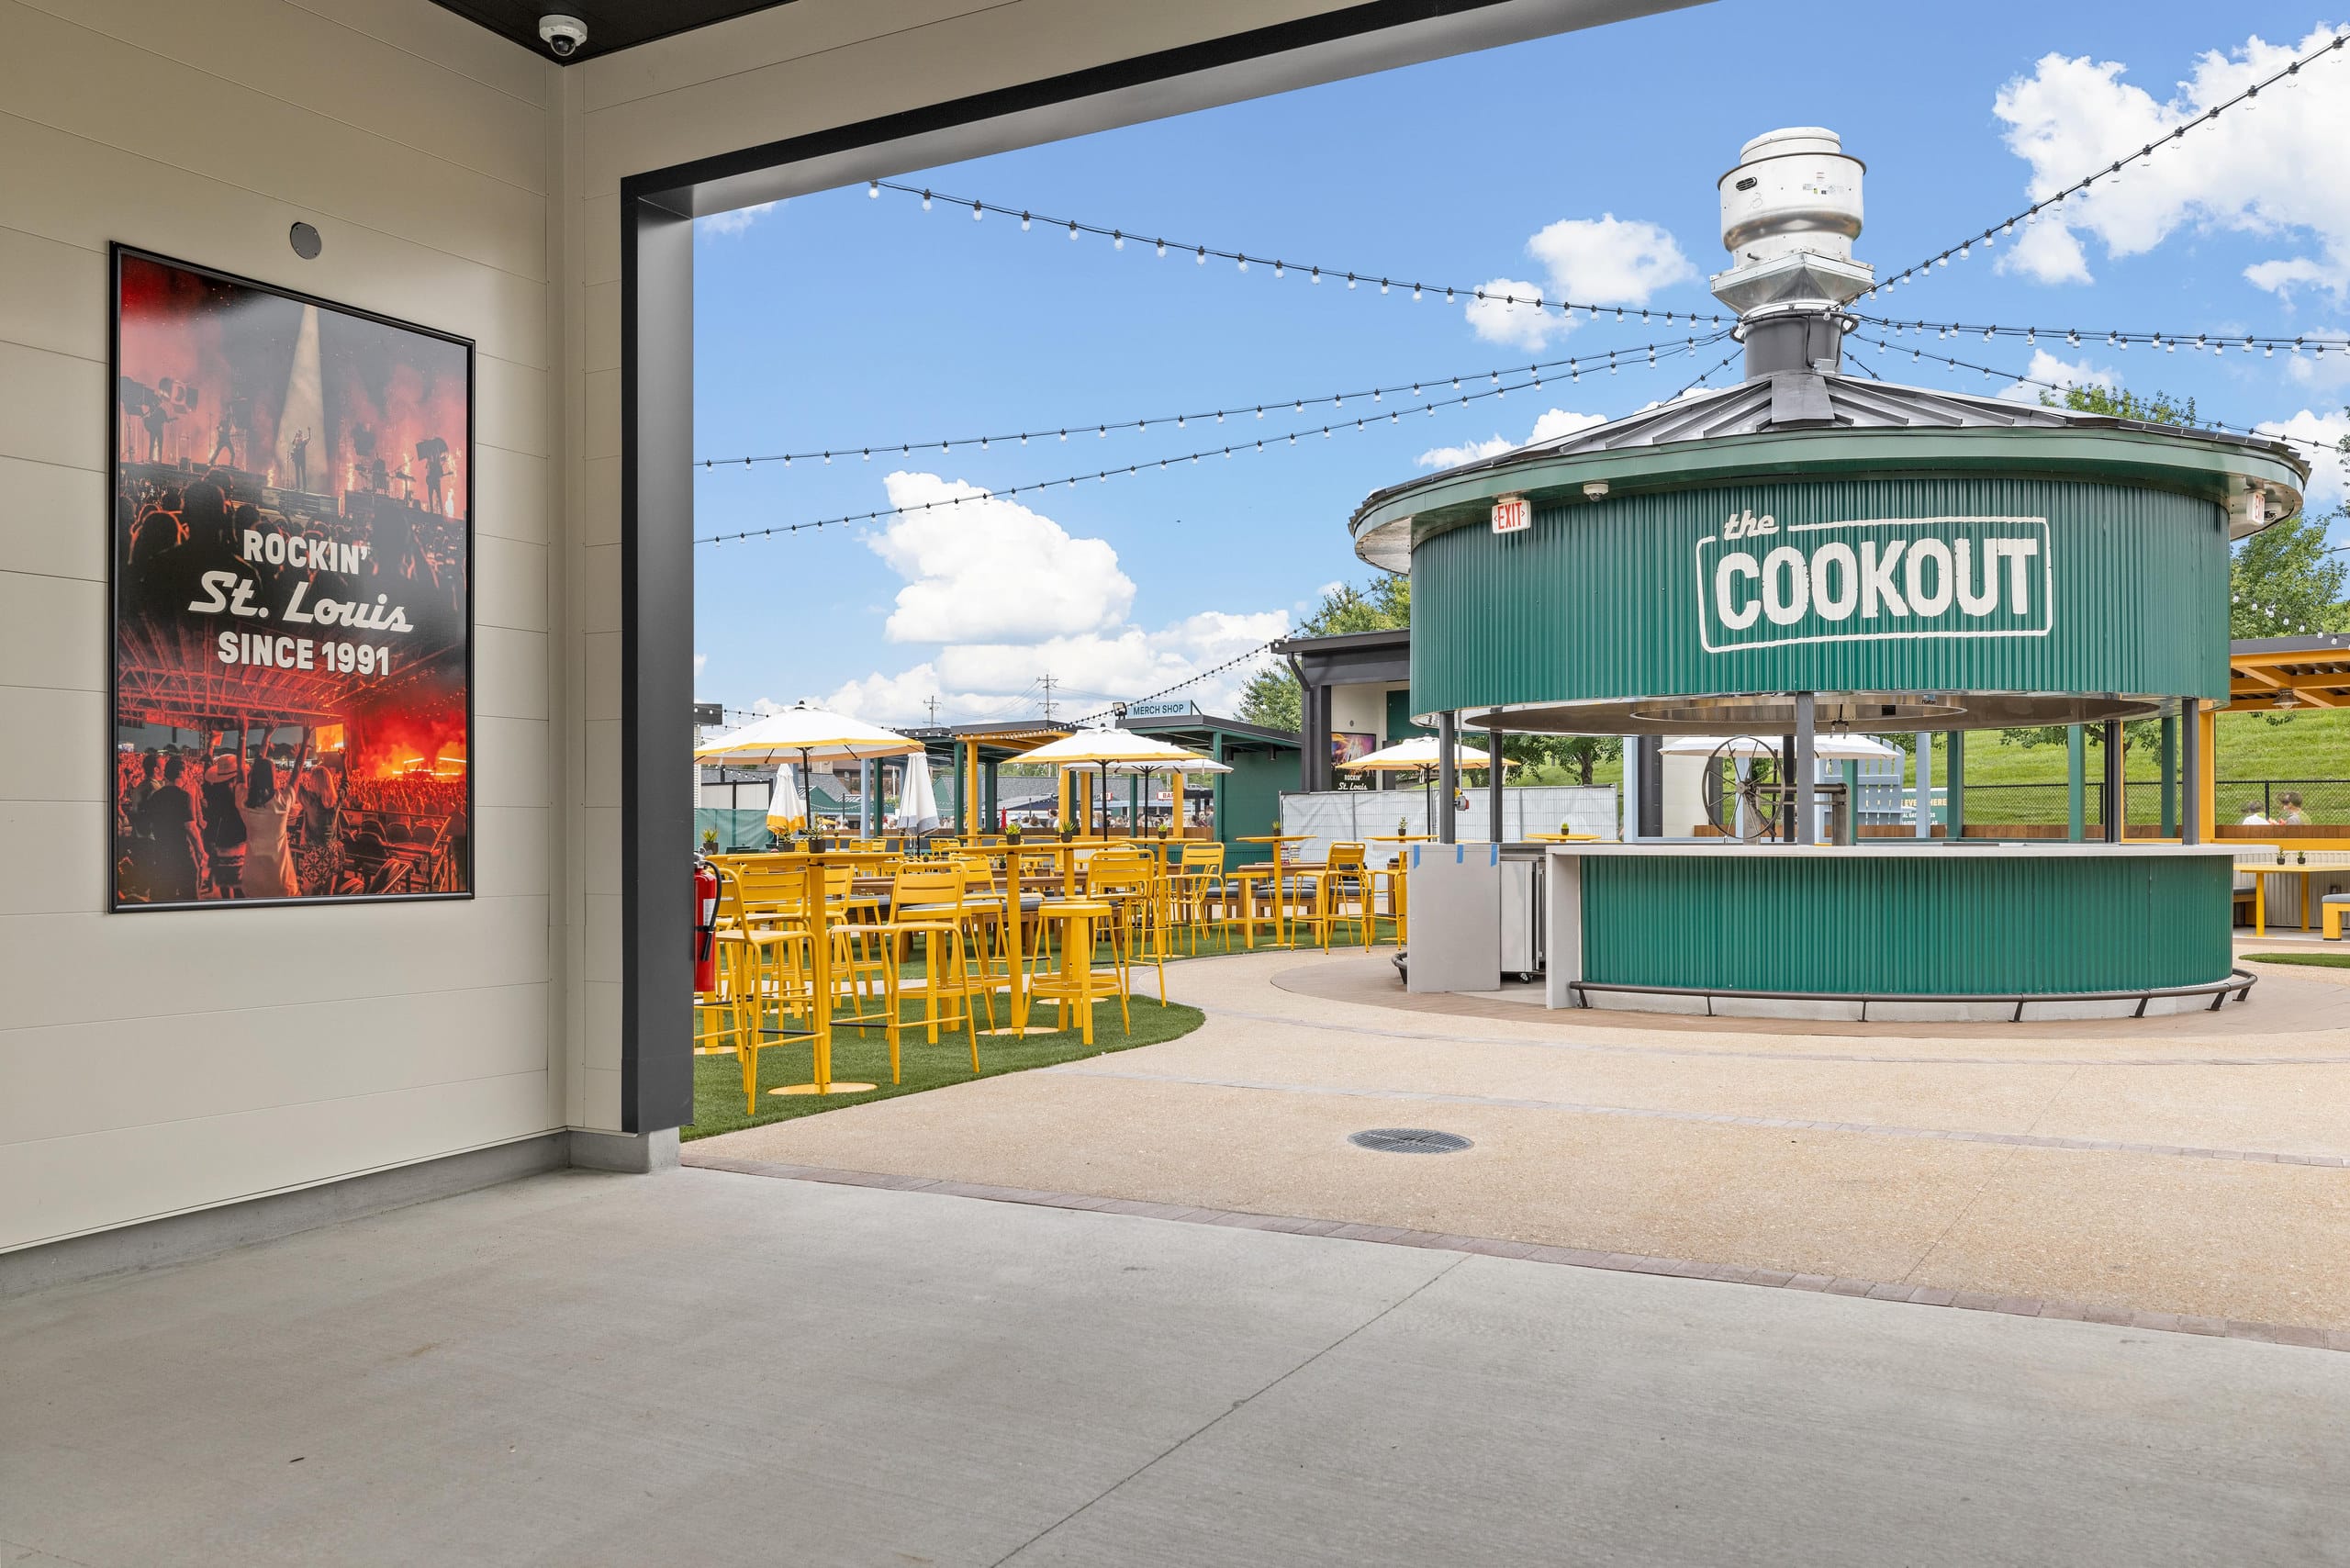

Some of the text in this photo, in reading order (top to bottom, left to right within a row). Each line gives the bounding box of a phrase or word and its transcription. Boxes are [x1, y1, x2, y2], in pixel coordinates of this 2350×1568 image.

[1498, 502, 1522, 530] EXIT
[1724, 510, 1779, 540] the
[243, 529, 368, 575] ROCKIN'
[188, 570, 414, 633] St. Louis
[1716, 538, 2038, 630] COOKOUT
[218, 632, 389, 676] SINCE 1991
[1133, 704, 1184, 715] MERCH SHOP
[1349, 782, 1368, 790] Louis
